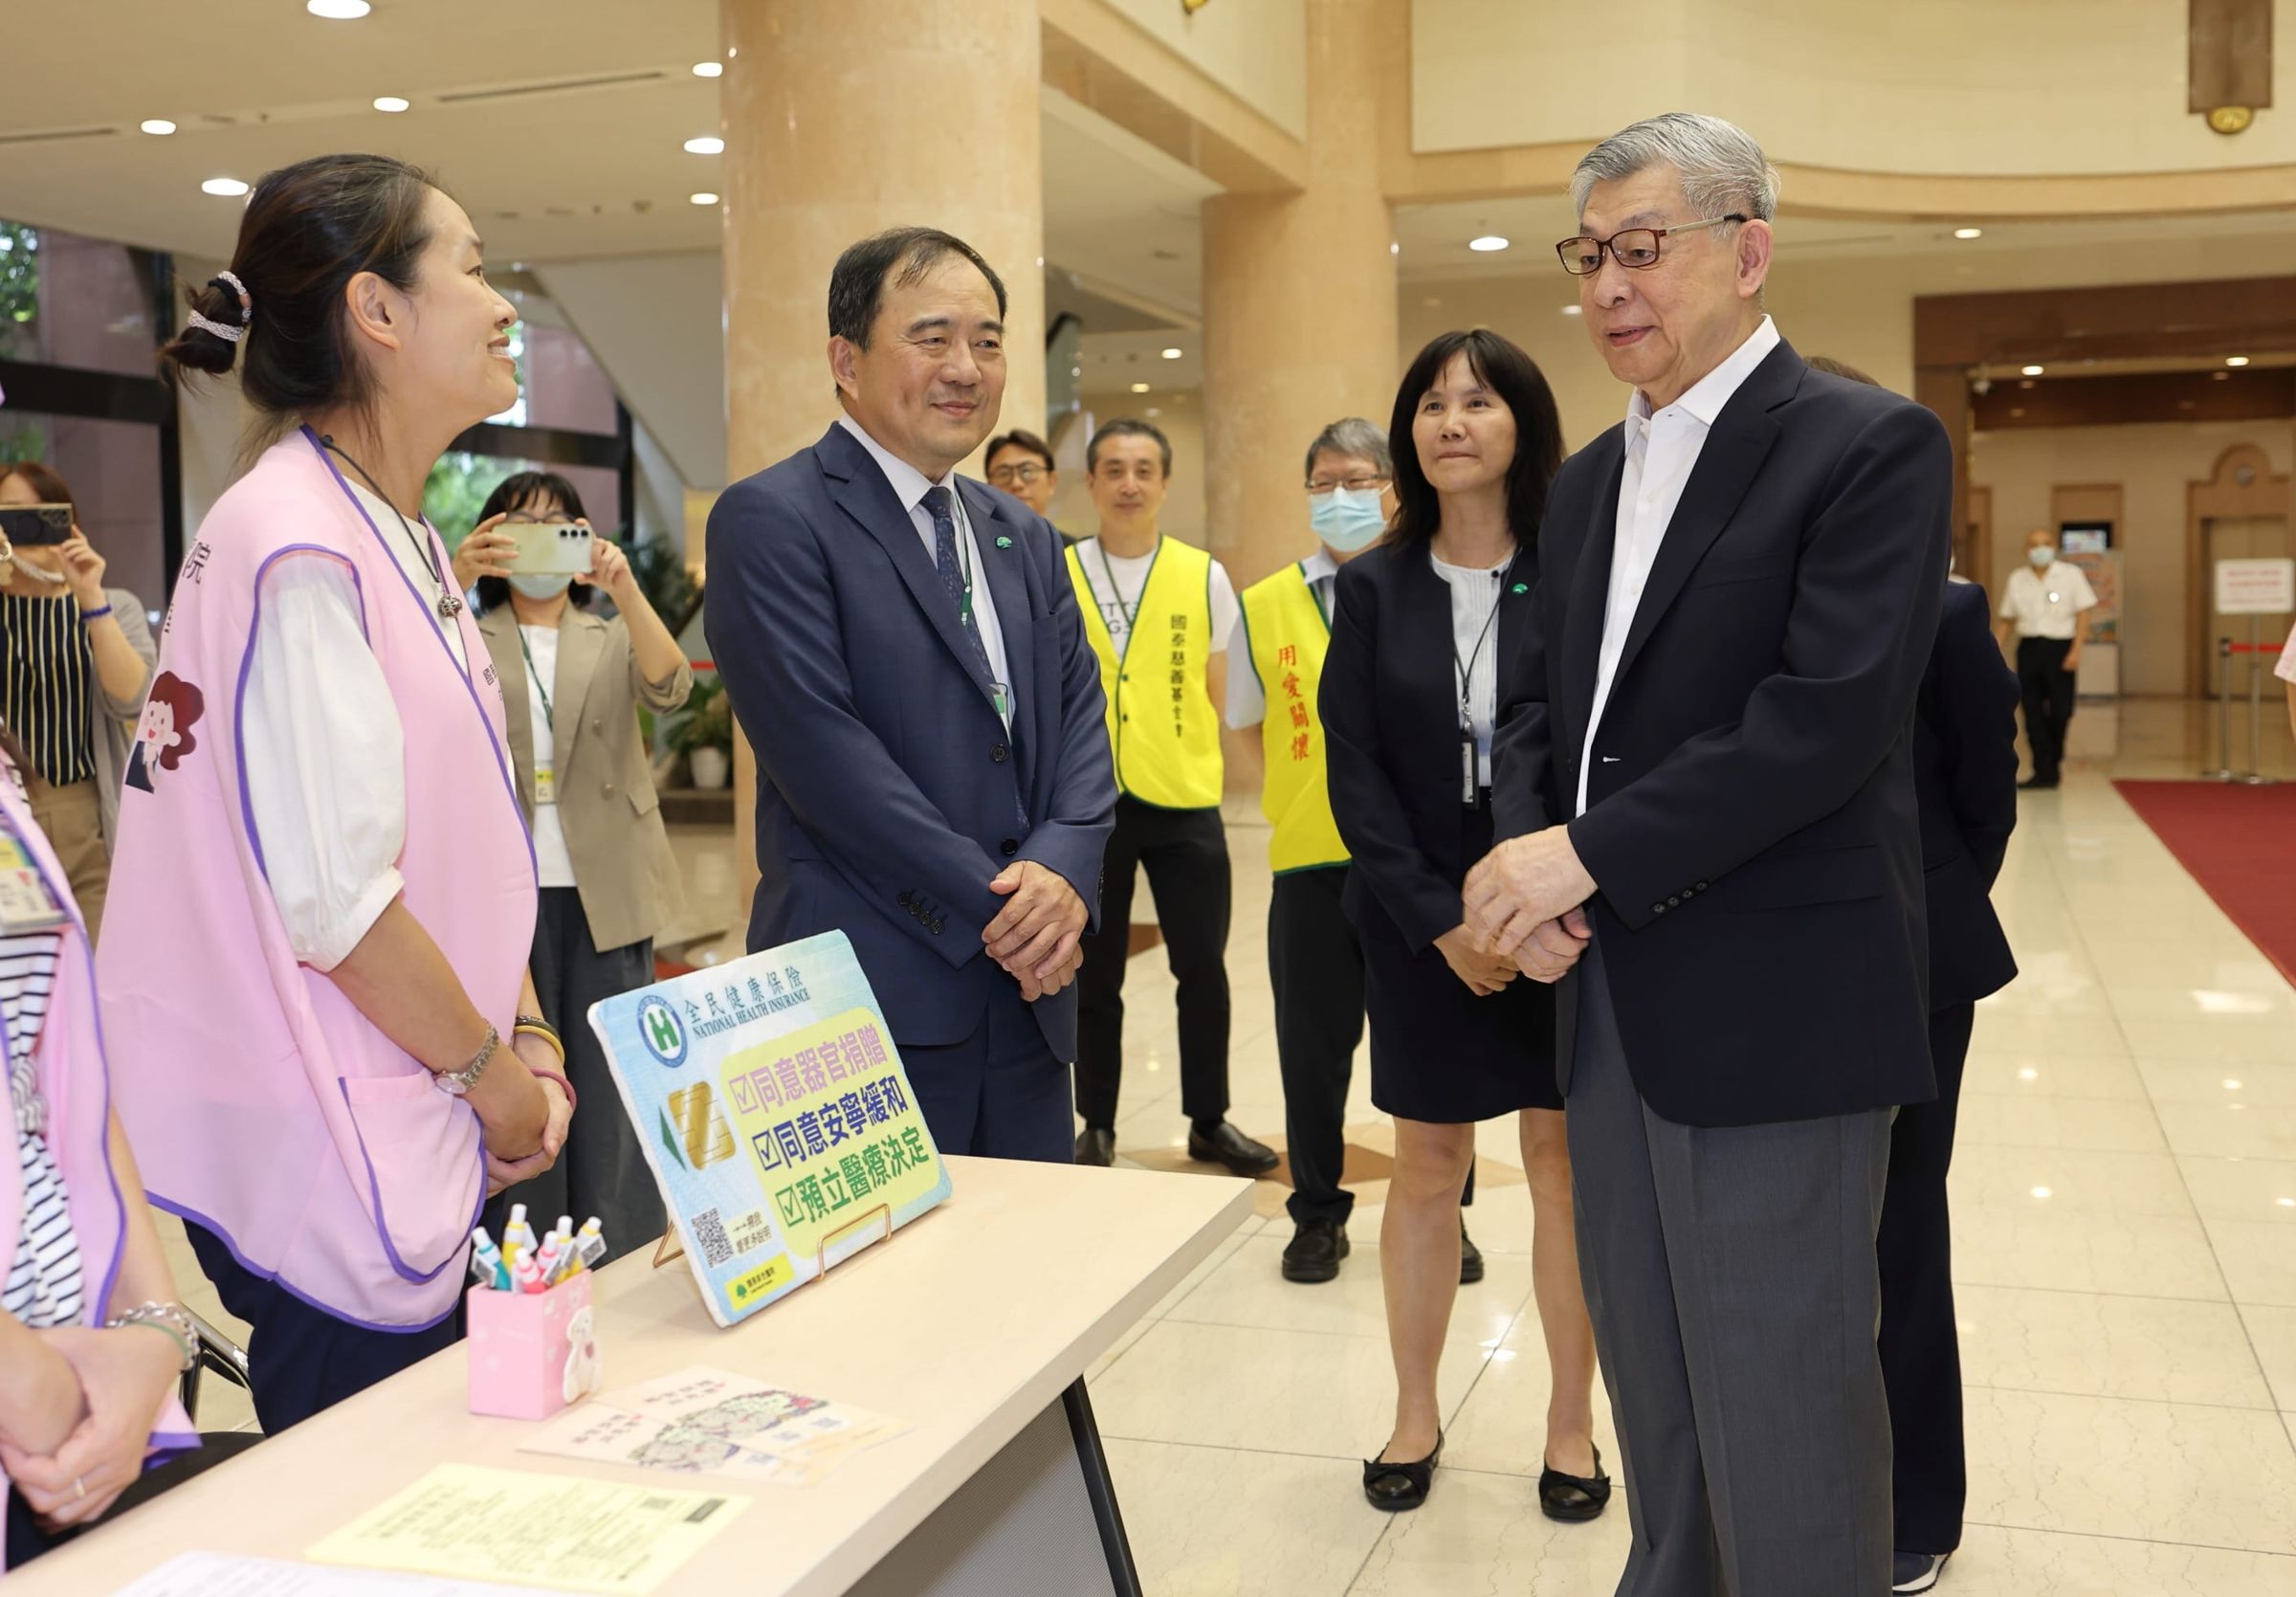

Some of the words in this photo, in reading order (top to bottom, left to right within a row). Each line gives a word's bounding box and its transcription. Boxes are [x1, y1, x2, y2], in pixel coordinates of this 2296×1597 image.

[1278, 645, 1309, 761] 用愛關懷
[684, 965, 804, 1024] 全民健康保險
[693, 1014, 737, 1041] NATIONAL
[736, 1002, 769, 1025] HEALTH
[767, 987, 810, 1013] INSURANCE
[750, 1023, 888, 1114] 同意器官捐贈
[774, 1074, 908, 1169] 同意安寧緩和
[795, 1125, 929, 1225] 預立醫療決定
